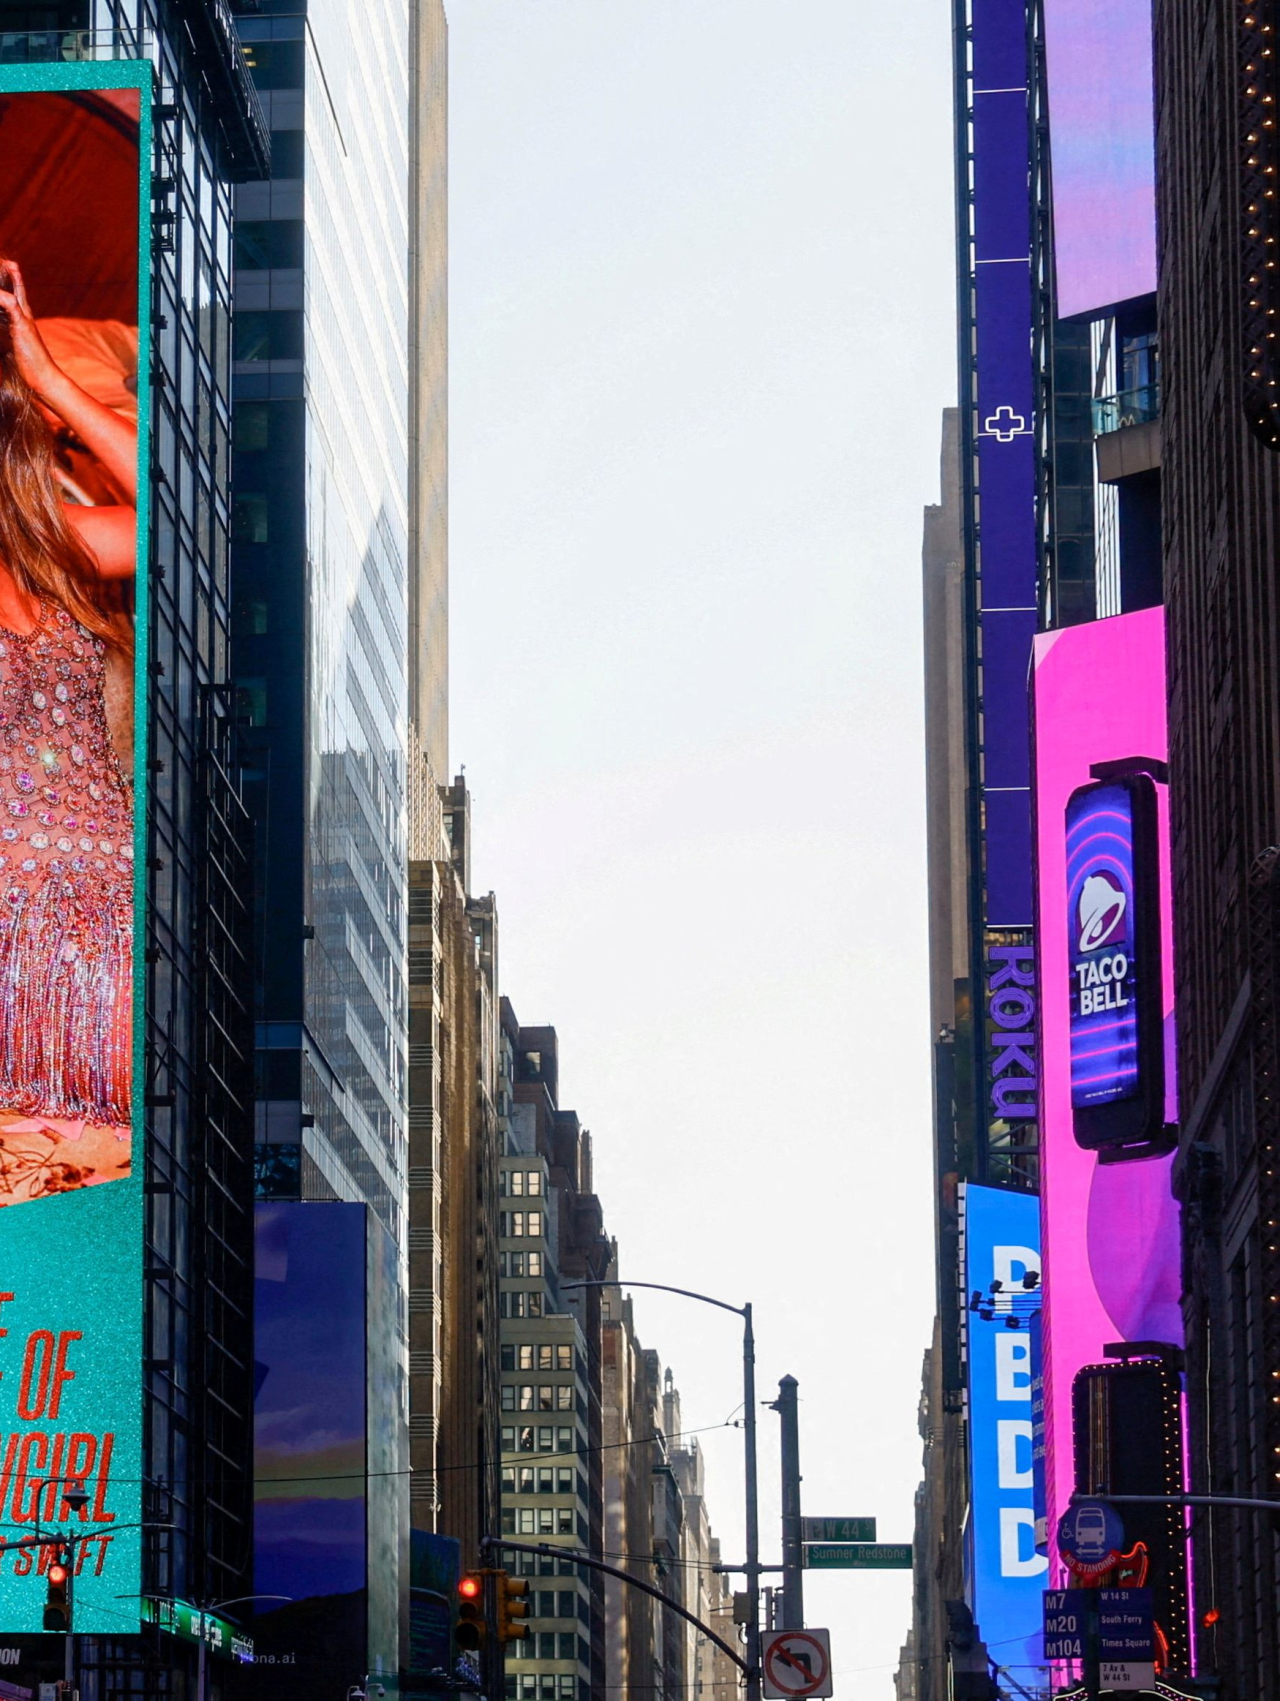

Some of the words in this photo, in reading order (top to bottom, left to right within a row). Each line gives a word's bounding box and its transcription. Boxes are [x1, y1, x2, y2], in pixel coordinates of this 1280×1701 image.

[1076, 952, 1128, 989] TACO
[1080, 982, 1129, 1016] BELL
[988, 945, 1036, 1118] ROKU
[17, 1329, 83, 1421] OF
[825, 1520, 837, 1539] W
[841, 1520, 860, 1539] 44
[13, 1534, 115, 1577] SWFT
[812, 1546, 854, 1559] Sumner
[858, 1546, 907, 1559] Redstone
[1064, 1554, 1076, 1567] NO
[1076, 1554, 1117, 1573] STANDING
[1045, 1593, 1066, 1609] M7
[1101, 1592, 1109, 1600] W
[1110, 1592, 1120, 1600] 14
[1046, 1615, 1077, 1633] M20
[1101, 1615, 1122, 1624] South
[1123, 1615, 1142, 1625] Ferry
[1046, 1639, 1082, 1657] M104
[1102, 1638, 1123, 1647] Times
[1125, 1638, 1151, 1649] Square
[1103, 1673, 1111, 1681] W
